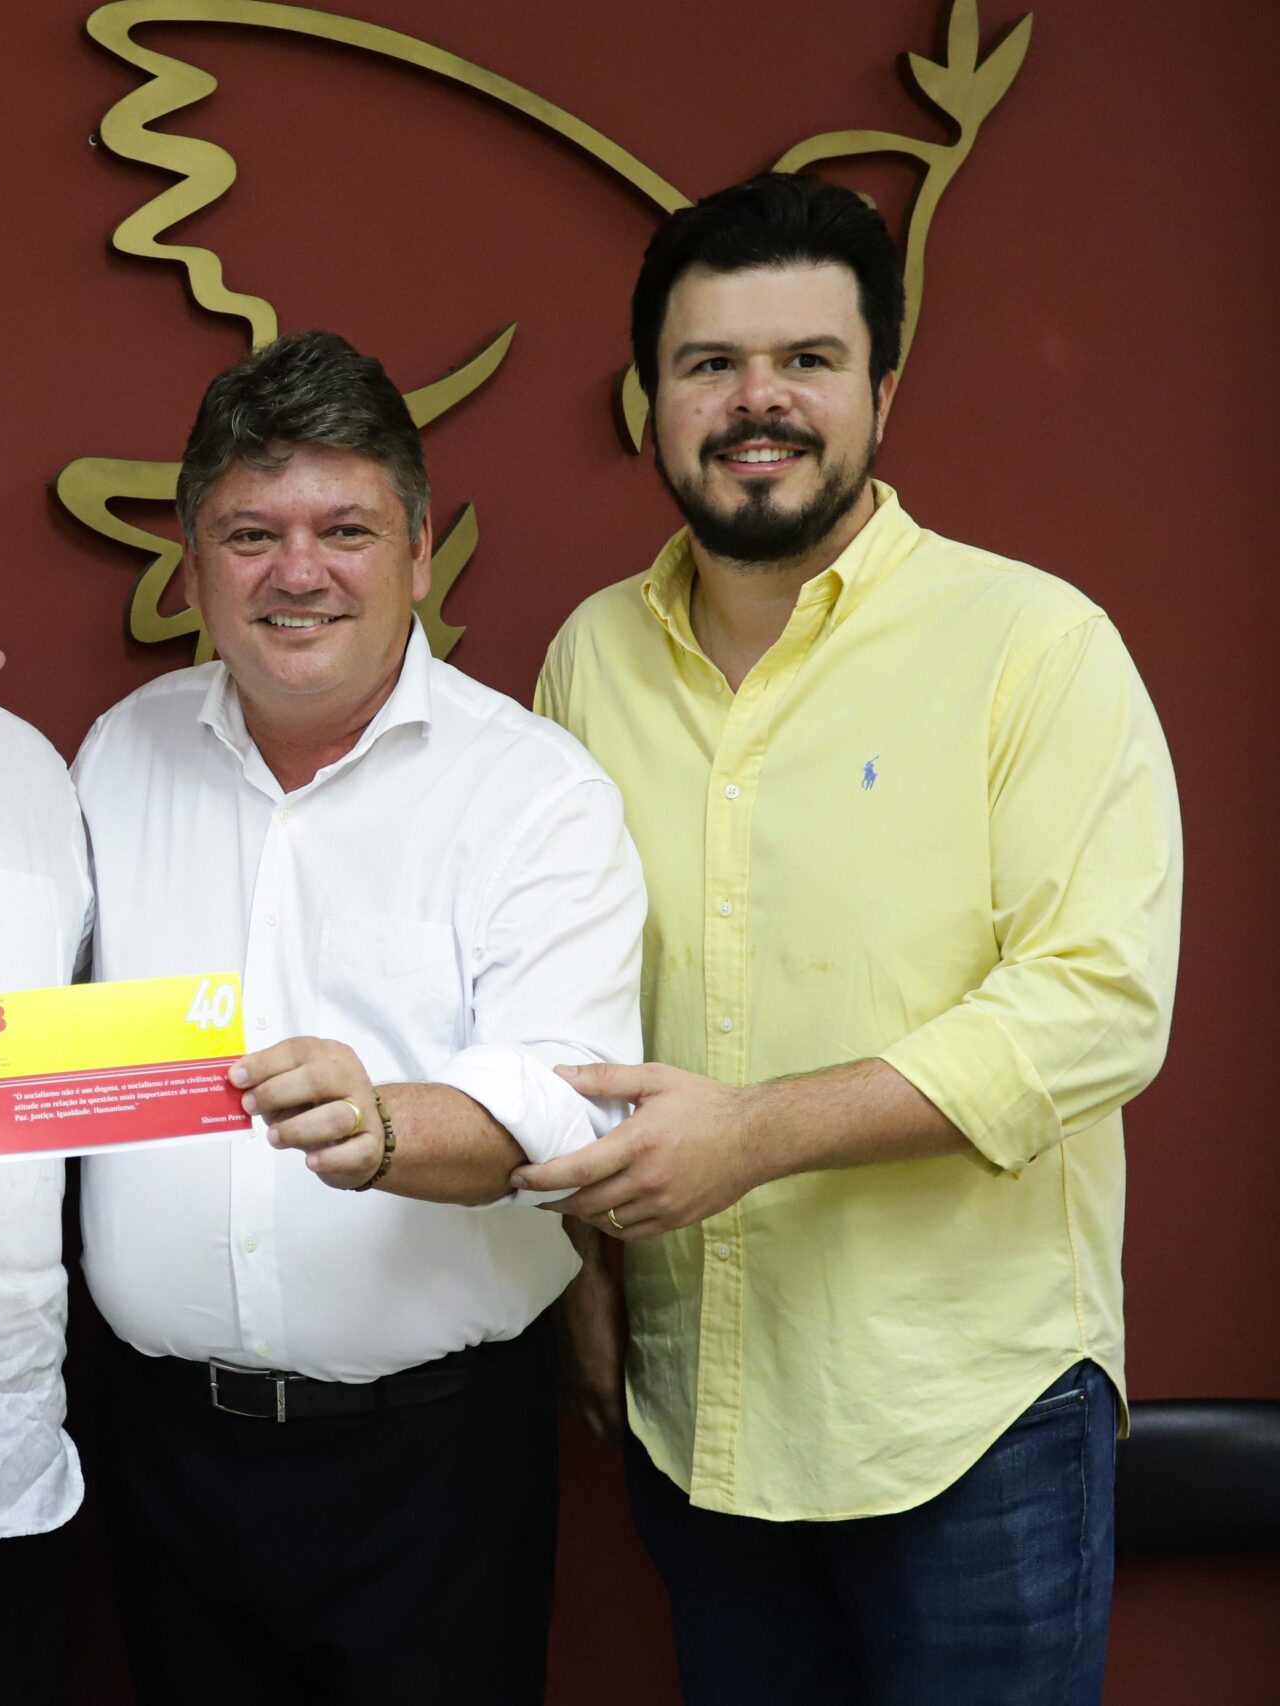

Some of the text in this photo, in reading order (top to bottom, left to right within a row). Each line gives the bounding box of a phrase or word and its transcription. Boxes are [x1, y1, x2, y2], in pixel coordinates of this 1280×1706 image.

[184, 980, 236, 1030] 40
[14, 1101, 39, 1111] atitude
[53, 1097, 78, 1107] relação
[88, 1095, 118, 1105] questões
[119, 1092, 136, 1101] mais
[137, 1089, 178, 1100] importantes
[179, 1087, 188, 1095] de
[24, 1090, 60, 1100] socialismo
[128, 1079, 163, 1089] socialismo
[201, 1113, 245, 1123] Shimon Peres
